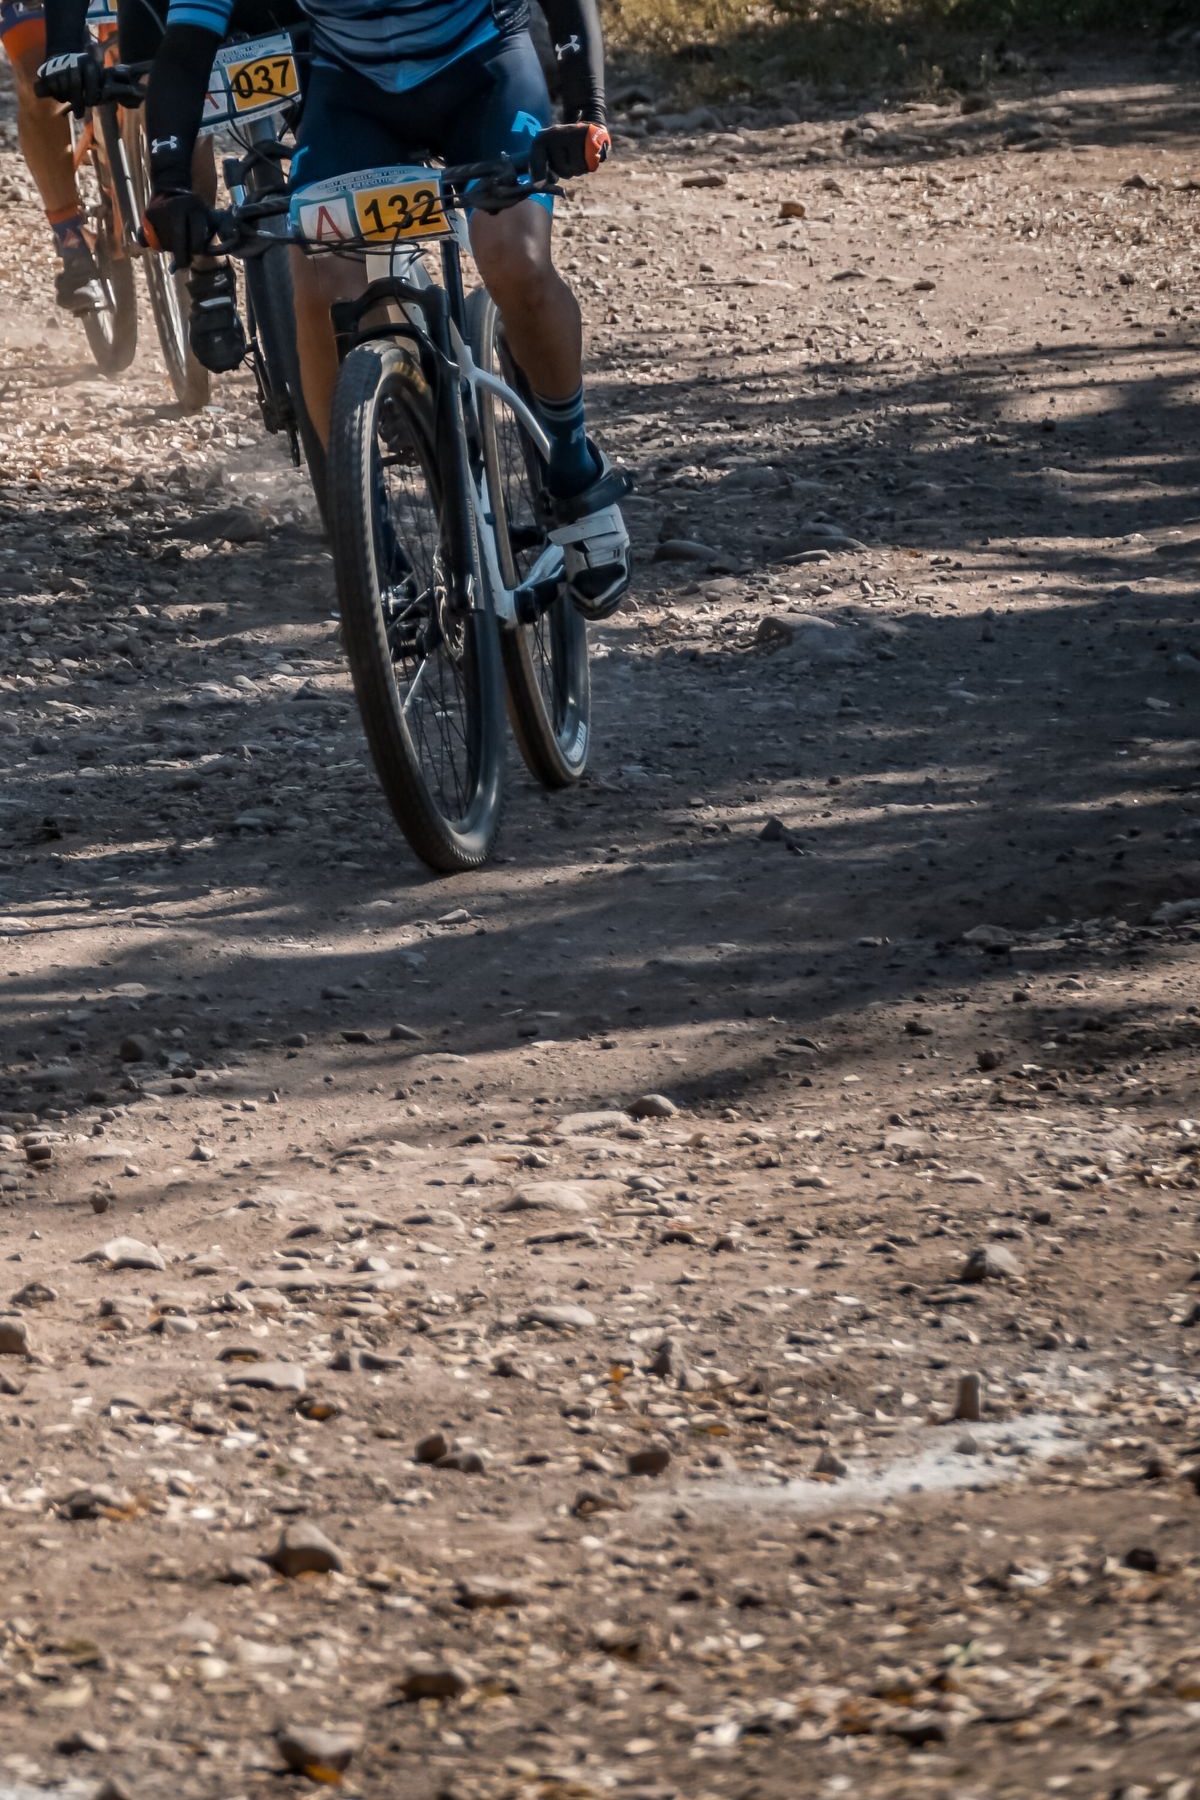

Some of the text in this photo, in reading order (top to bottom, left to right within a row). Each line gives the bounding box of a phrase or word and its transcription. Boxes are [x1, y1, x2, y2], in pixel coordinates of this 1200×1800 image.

[235, 59, 290, 99] 037
[316, 189, 441, 241] A 132
